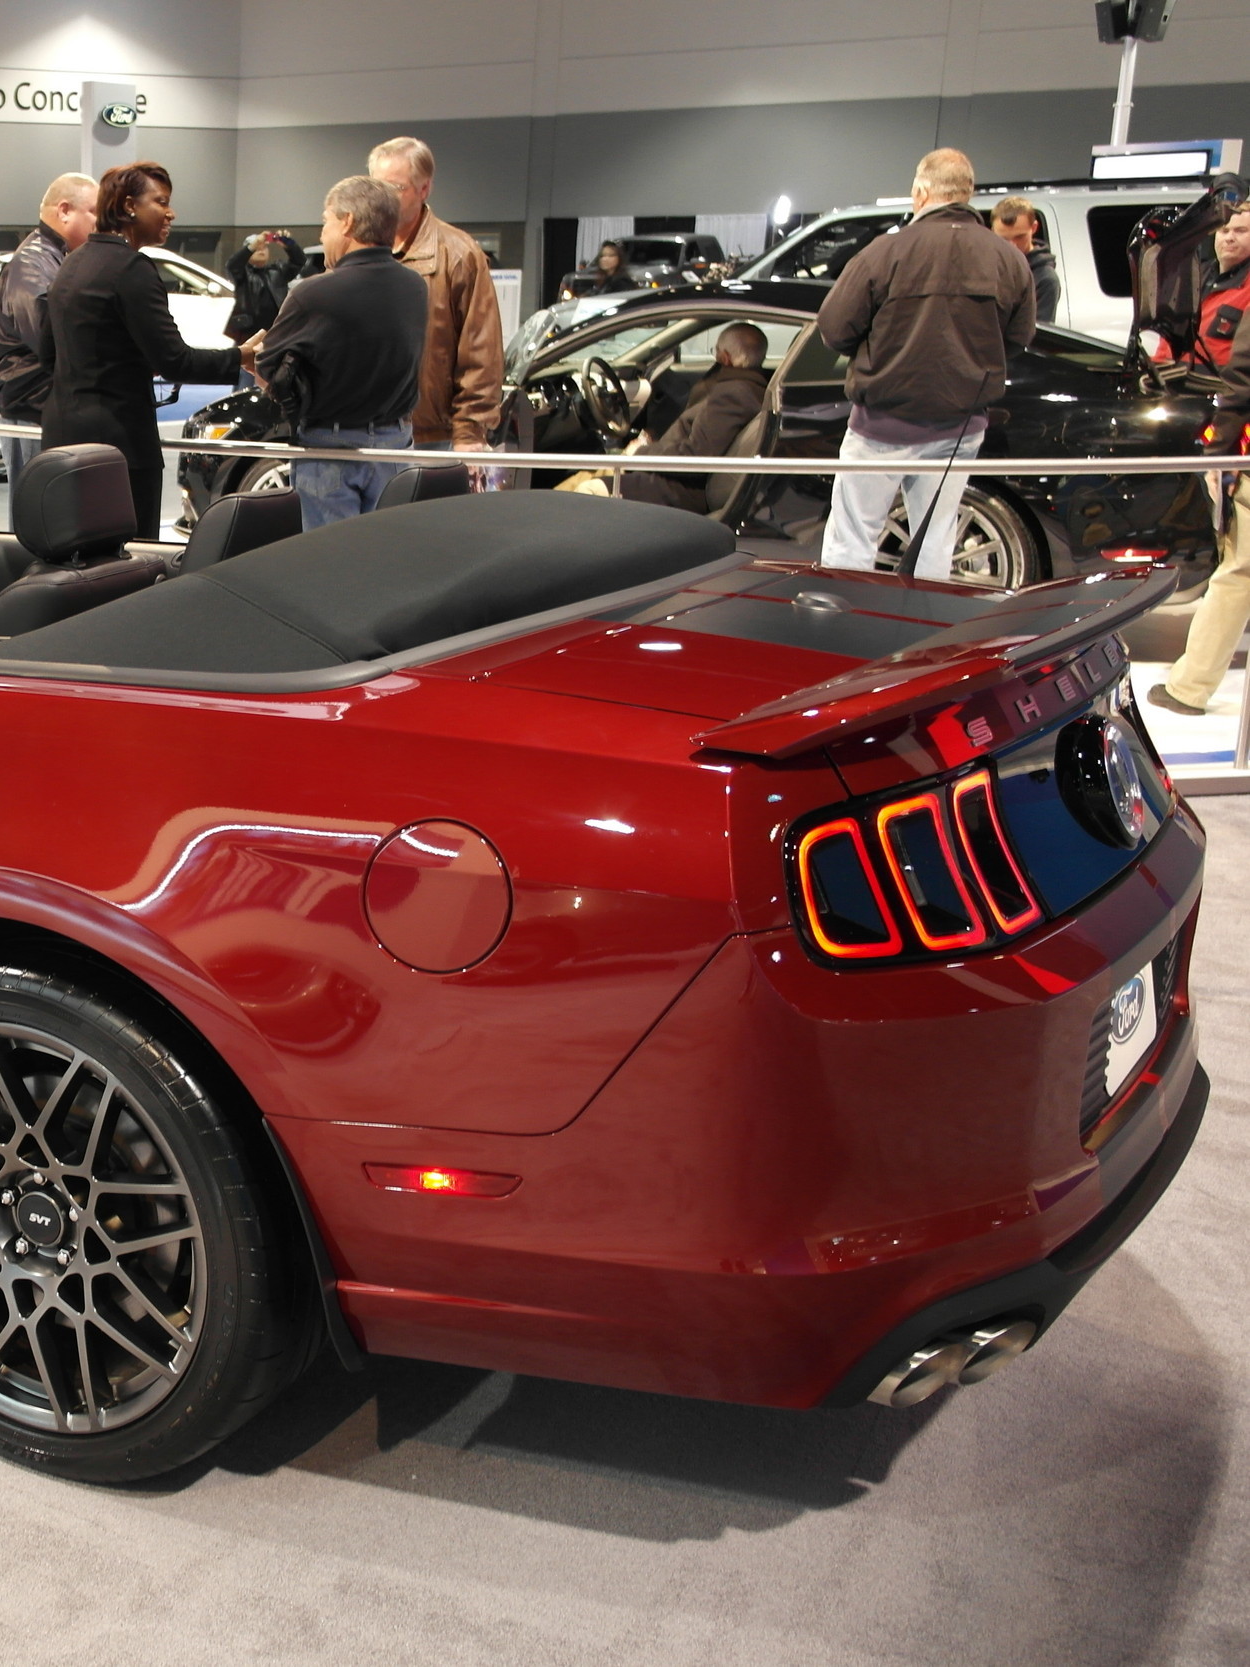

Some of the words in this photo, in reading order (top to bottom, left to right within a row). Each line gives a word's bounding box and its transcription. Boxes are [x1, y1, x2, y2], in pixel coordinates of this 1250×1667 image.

[14, 82, 147, 114] Conce
[110, 107, 134, 123] Ford
[1118, 983, 1139, 1037] Ford
[29, 1212, 51, 1227] SVT
